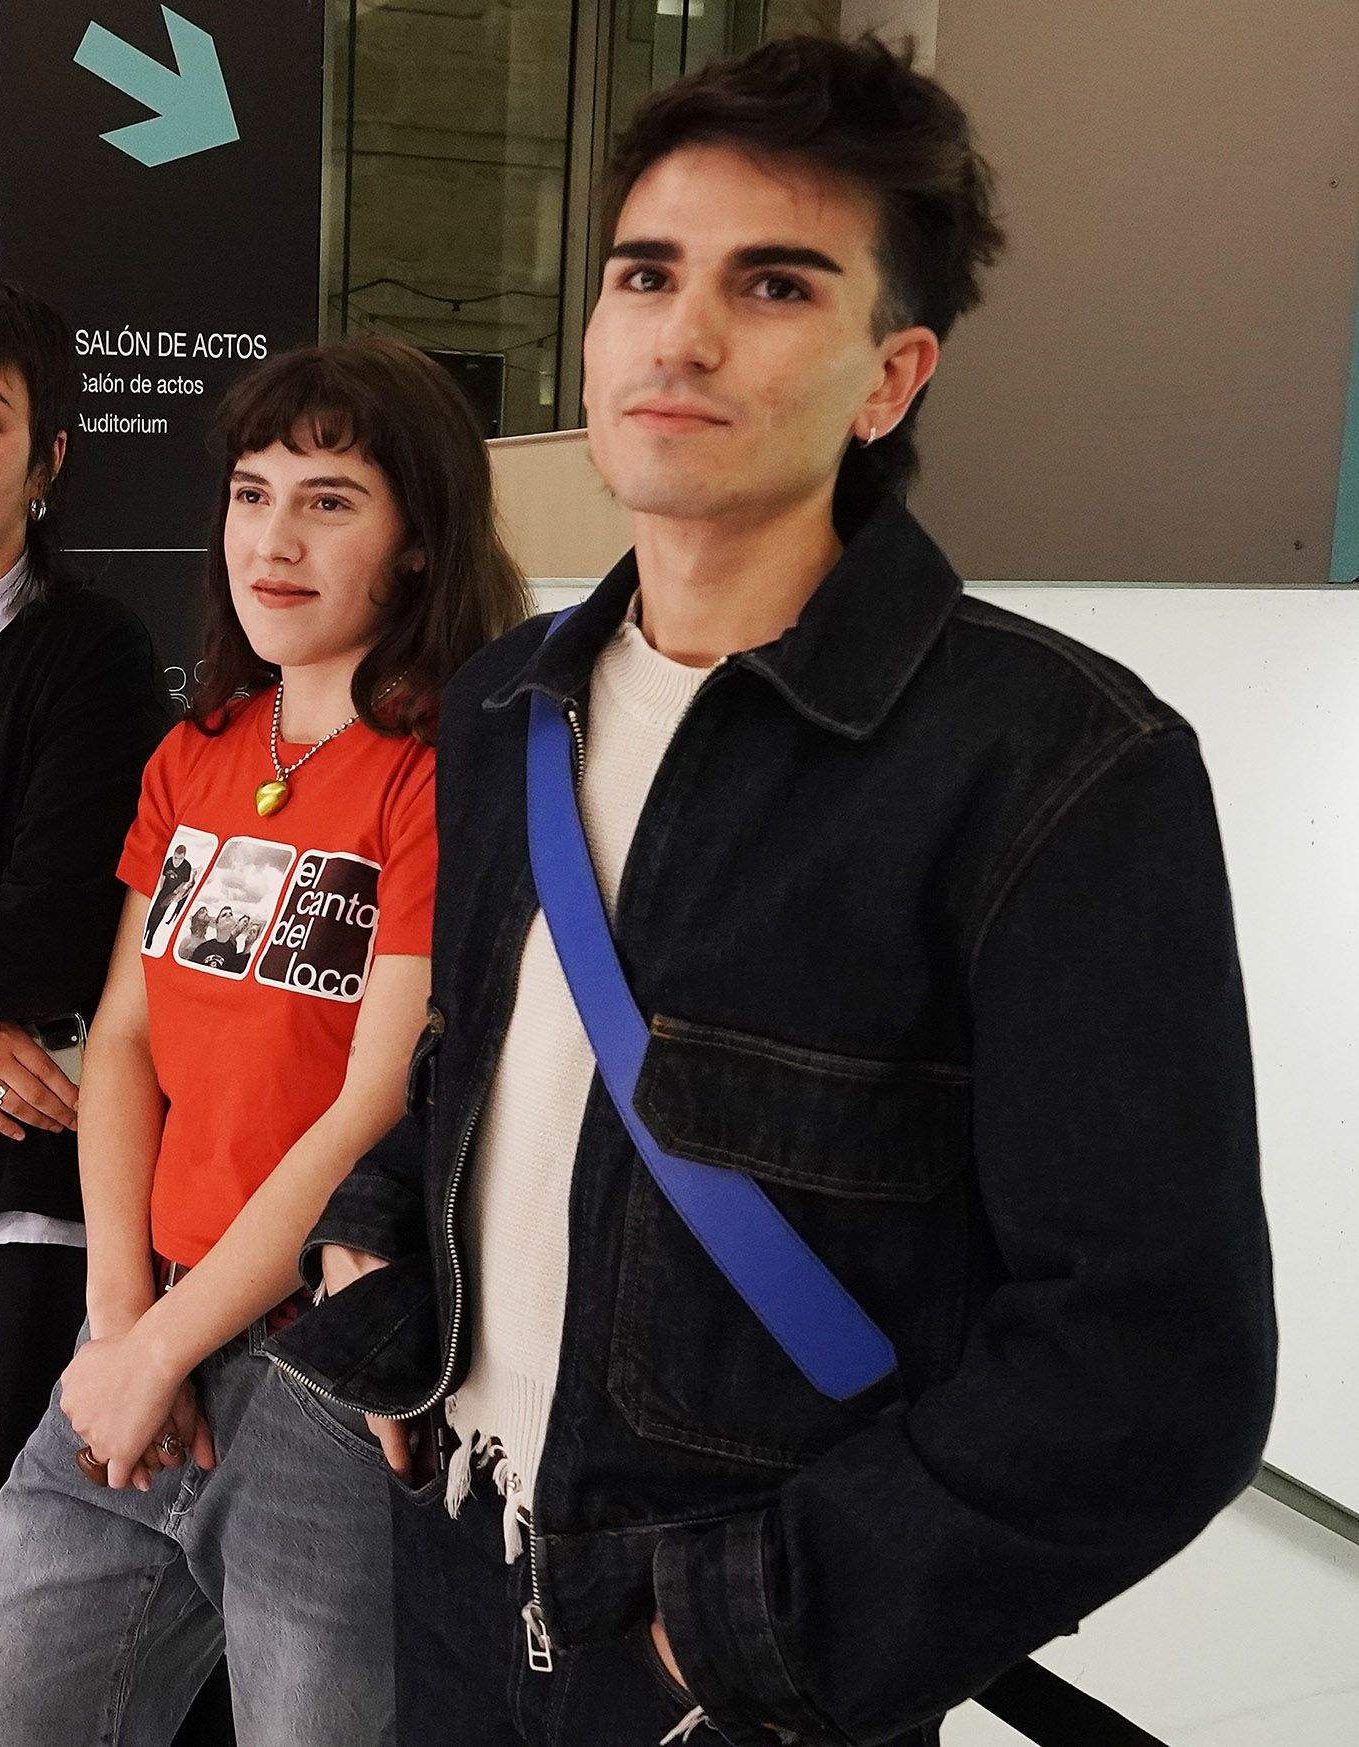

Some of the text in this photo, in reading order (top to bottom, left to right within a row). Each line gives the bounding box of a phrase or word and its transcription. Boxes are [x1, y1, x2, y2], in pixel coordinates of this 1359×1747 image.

[75, 324, 268, 360] SALÓN DE ACTOS
[129, 373, 152, 394] de
[156, 375, 204, 395] actos
[295, 857, 328, 889] el
[296, 890, 378, 929] canto
[272, 914, 315, 951] del
[284, 951, 364, 999] loco
